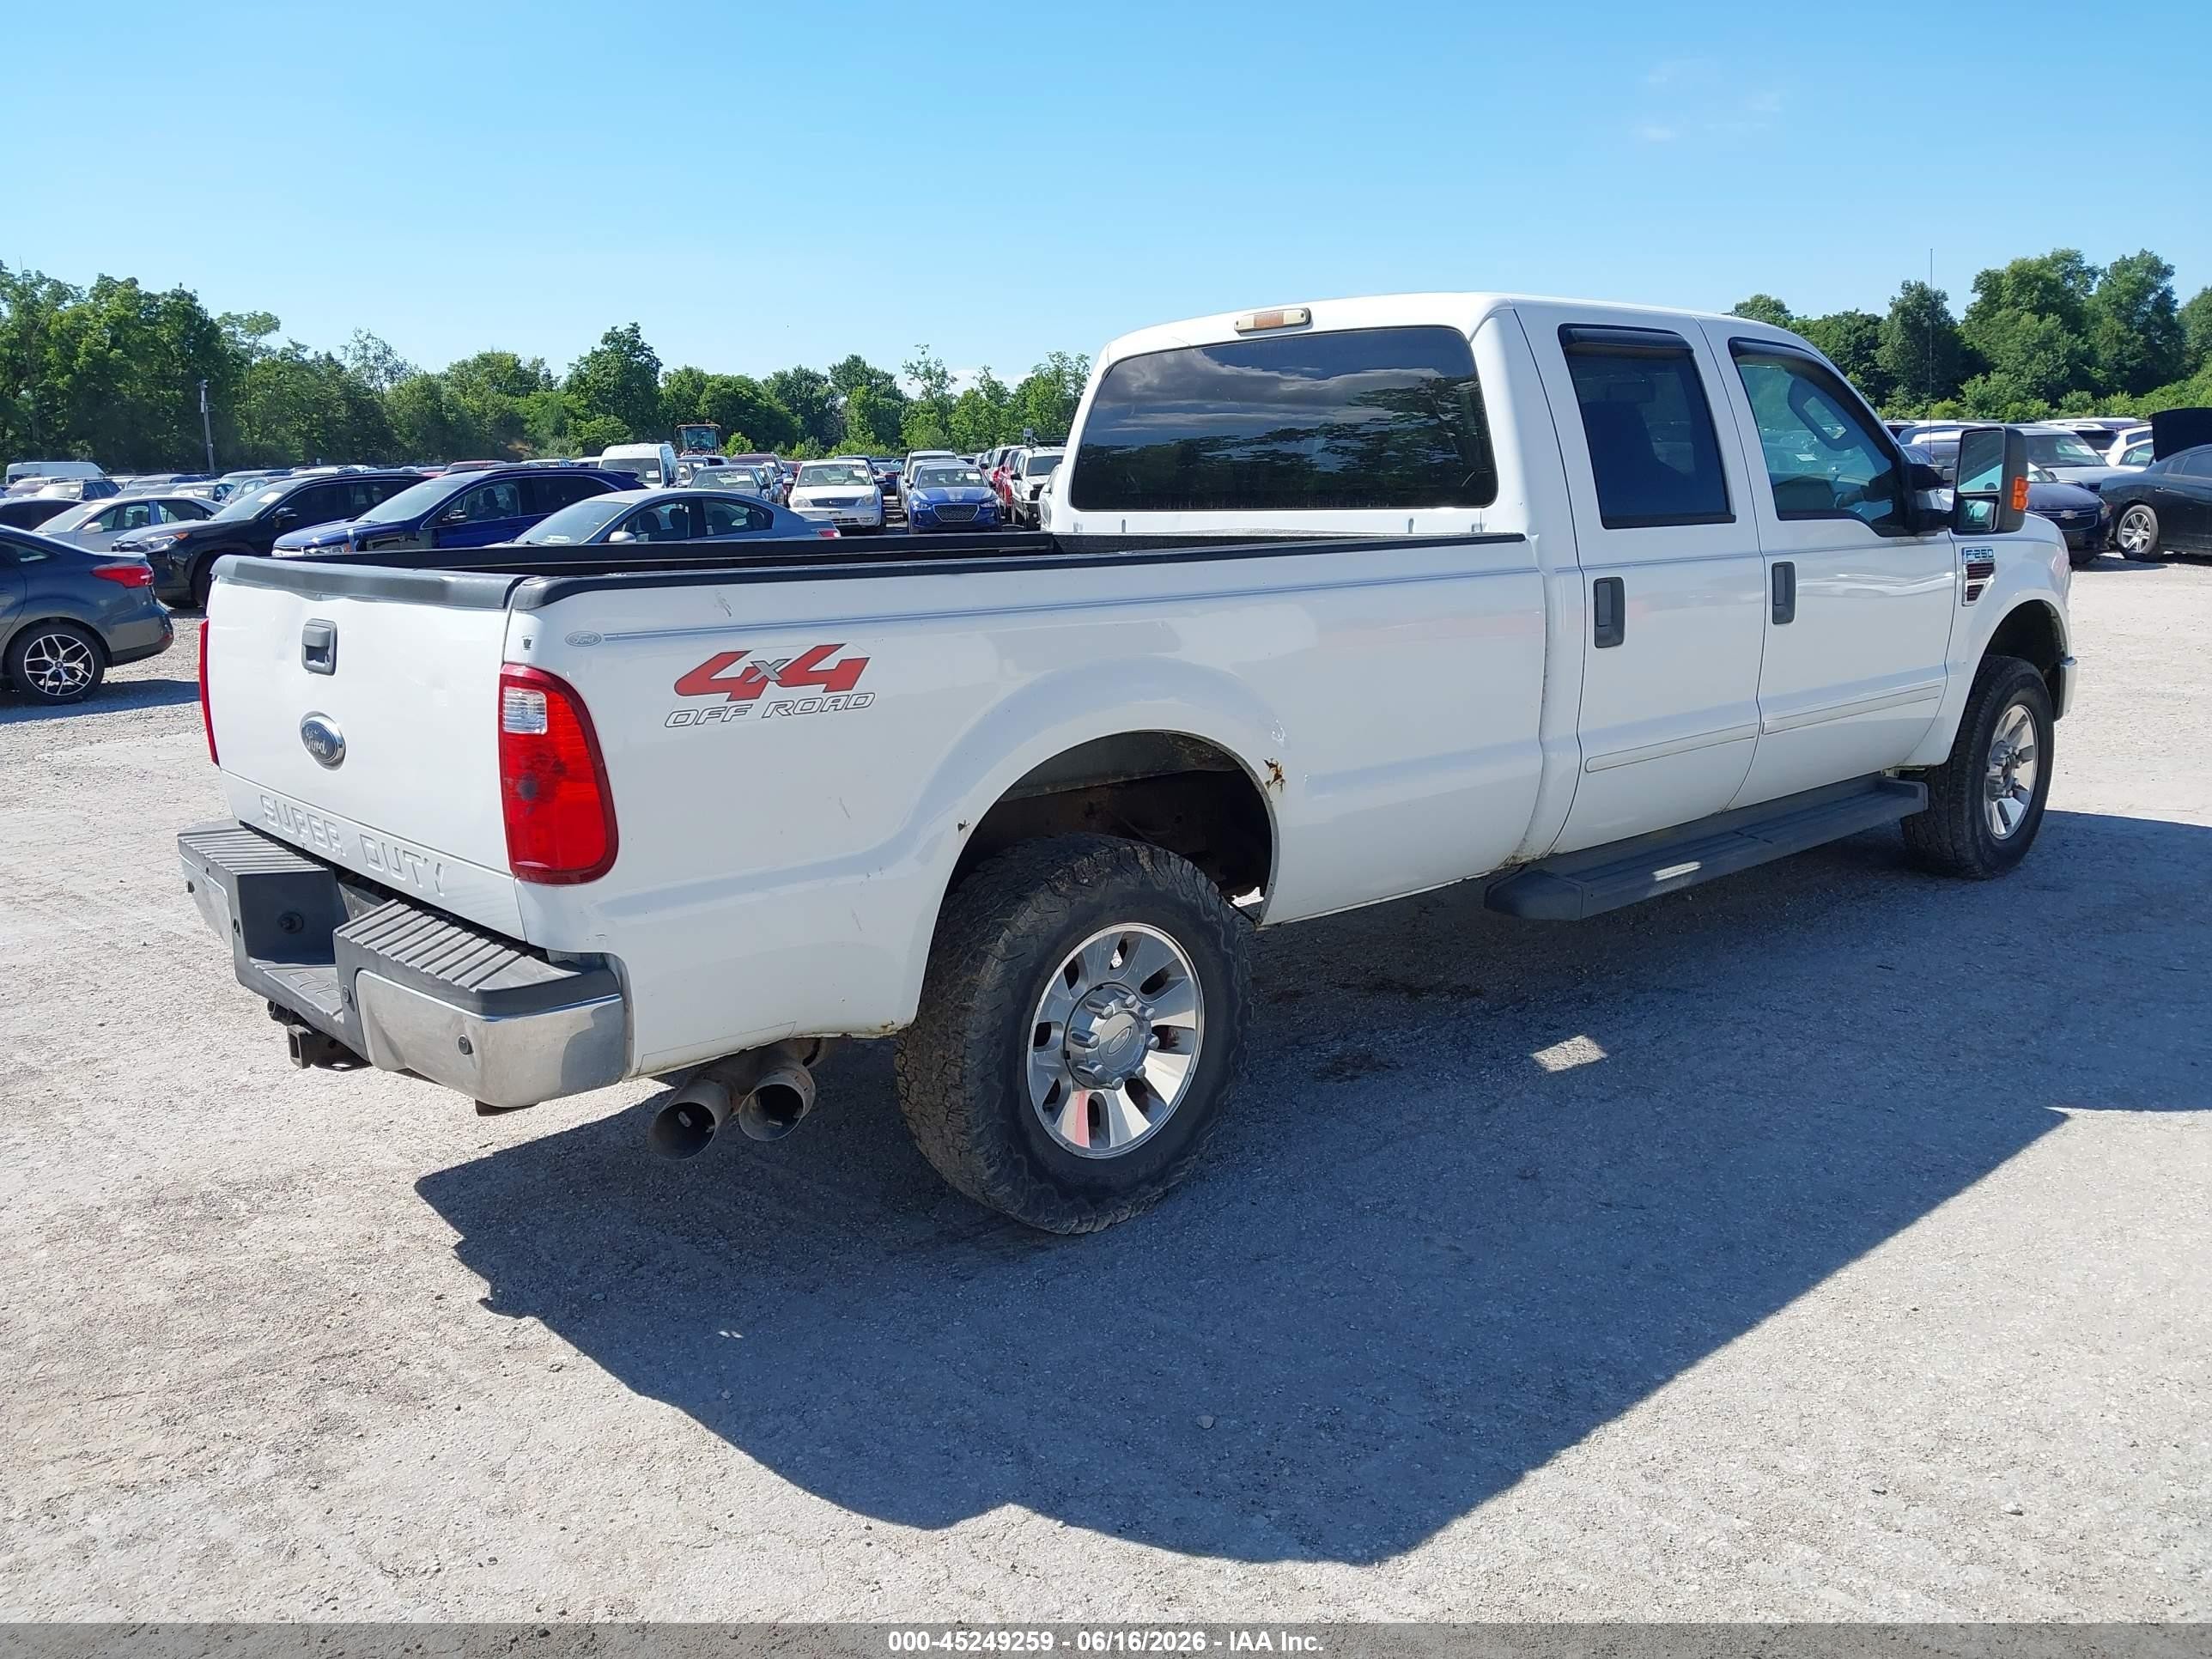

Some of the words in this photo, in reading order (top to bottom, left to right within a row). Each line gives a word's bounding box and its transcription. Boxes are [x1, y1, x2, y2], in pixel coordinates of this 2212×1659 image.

[1966, 549, 1995, 559] F-250
[664, 702, 754, 728] OFF
[761, 692, 877, 720] ROAD
[259, 794, 347, 857] SUPER
[359, 833, 446, 897] DUTY
